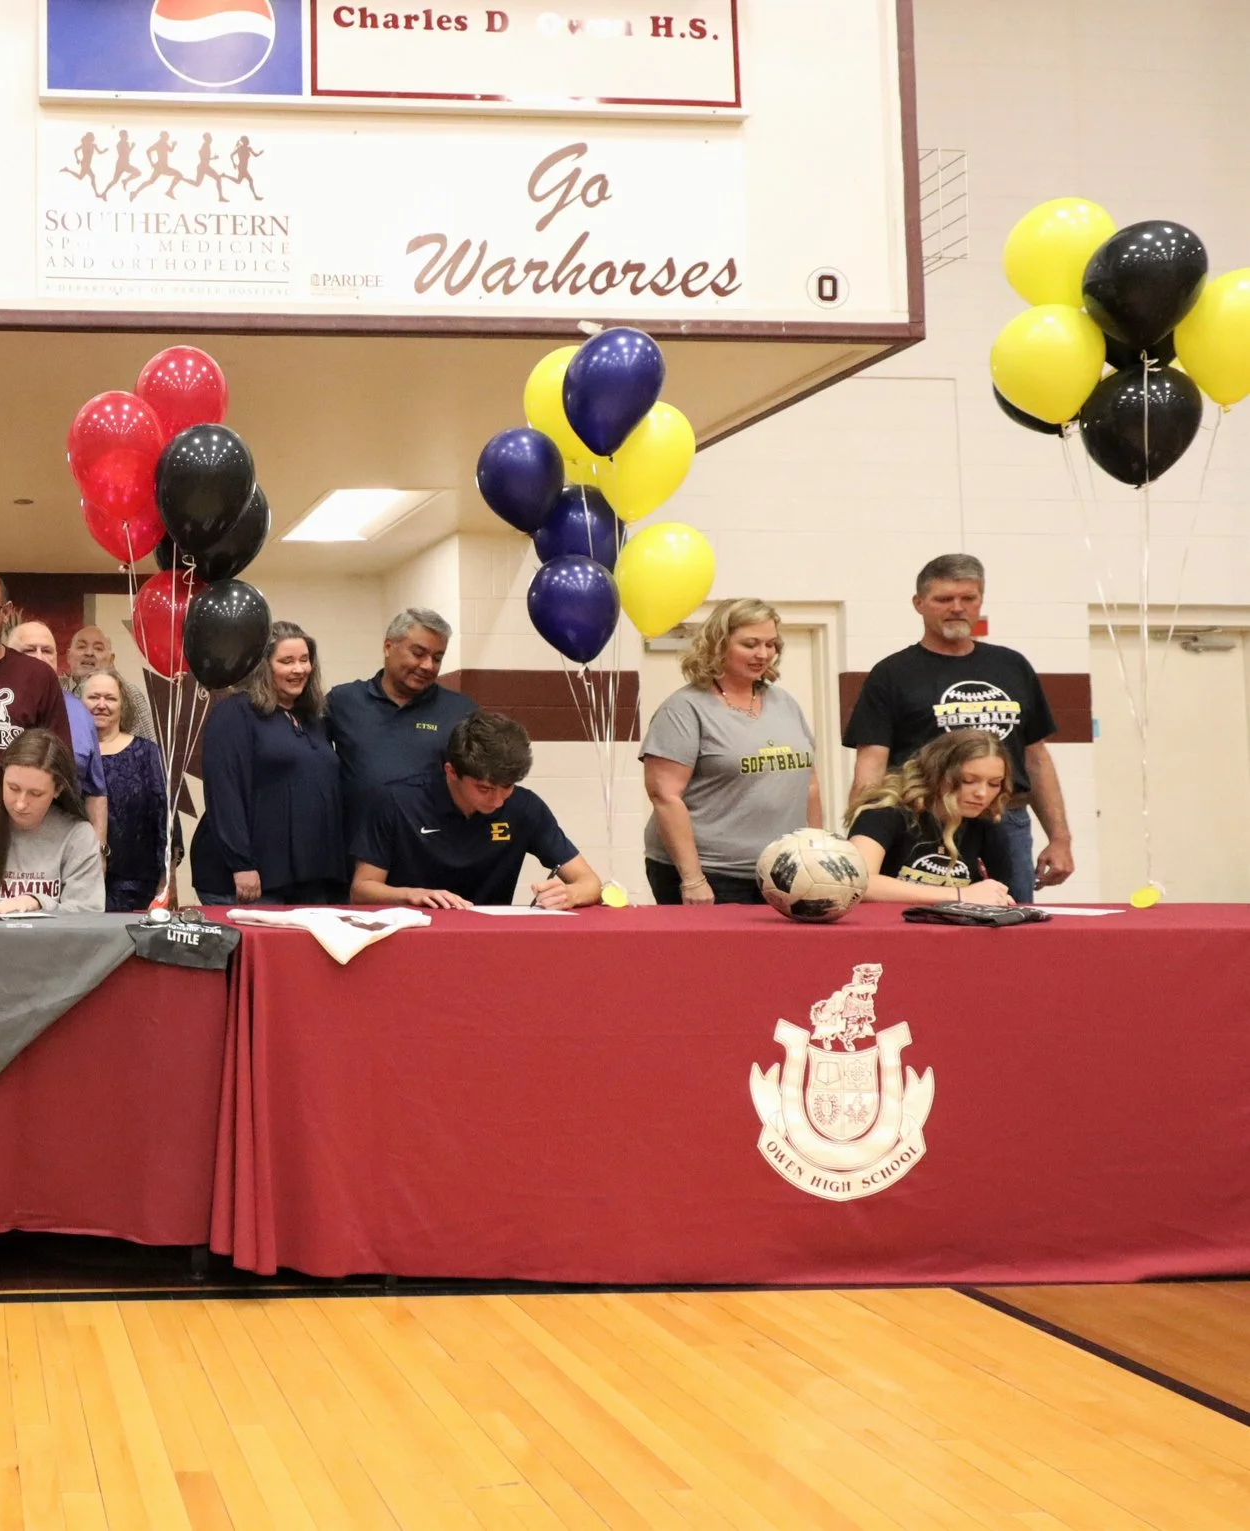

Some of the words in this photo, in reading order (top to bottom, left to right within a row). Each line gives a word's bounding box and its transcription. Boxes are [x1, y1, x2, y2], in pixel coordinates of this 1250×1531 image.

[332, 5, 469, 32] Charles
[650, 15, 719, 41] H.S.
[527, 142, 613, 232] Go
[158, 240, 292, 256] MEDICINE
[45, 255, 95, 270] AND
[111, 257, 291, 274] ORTHOPEDICS
[405, 231, 742, 298] Warhorses
[323, 273, 384, 288] PARDEE
[415, 722, 438, 731] ETSU
[937, 711, 1021, 728] SOFTBALL
[741, 751, 813, 774] SOFTBALL
[491, 822, 511, 841] E
[167, 929, 200, 946] LITTLE
[766, 1140, 805, 1180] OWEN
[810, 1175, 851, 1193] HIGH
[861, 1144, 921, 1190] SCHOOL
